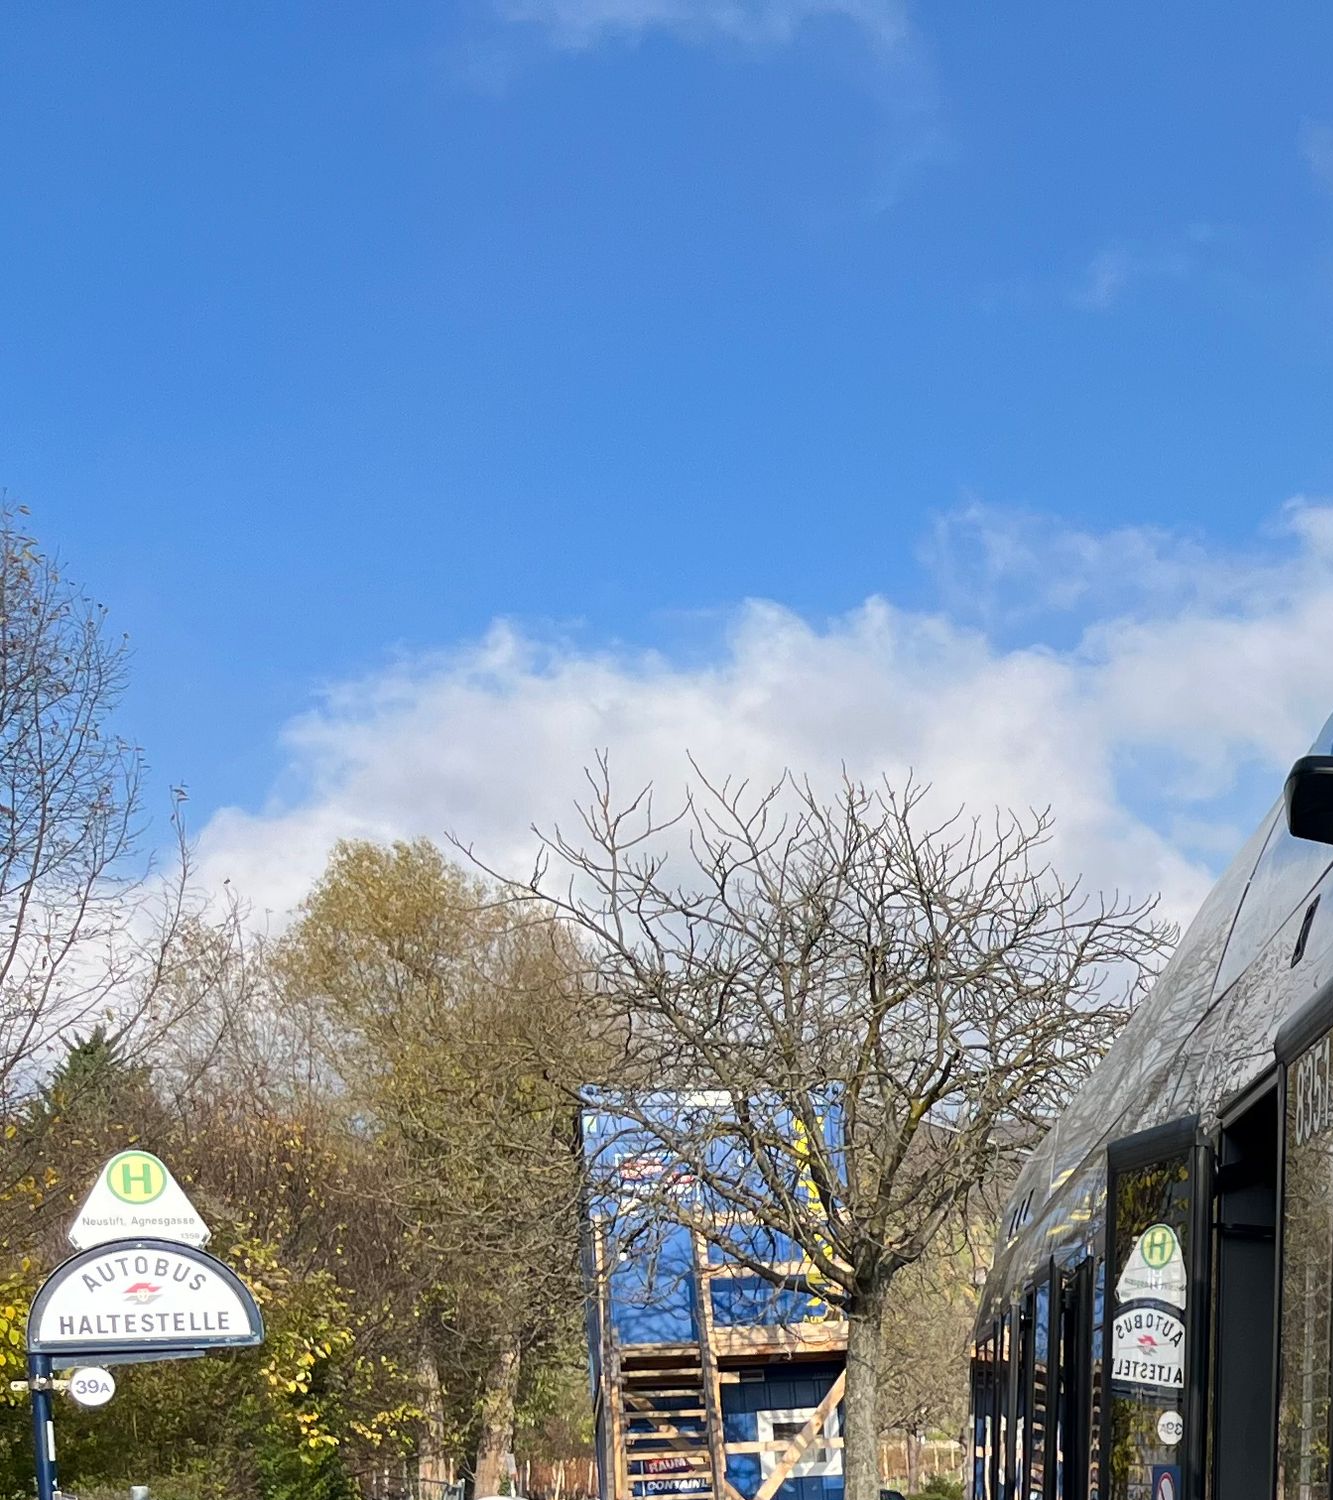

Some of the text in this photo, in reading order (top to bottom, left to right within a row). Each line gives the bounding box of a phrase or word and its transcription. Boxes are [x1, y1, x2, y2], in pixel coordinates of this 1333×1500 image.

[1295, 1036, 1331, 1147] 8351
[81, 1256, 207, 1293] AUTOBUS
[59, 1310, 230, 1335] HALTESTELLE
[75, 1379, 111, 1395] 39A
